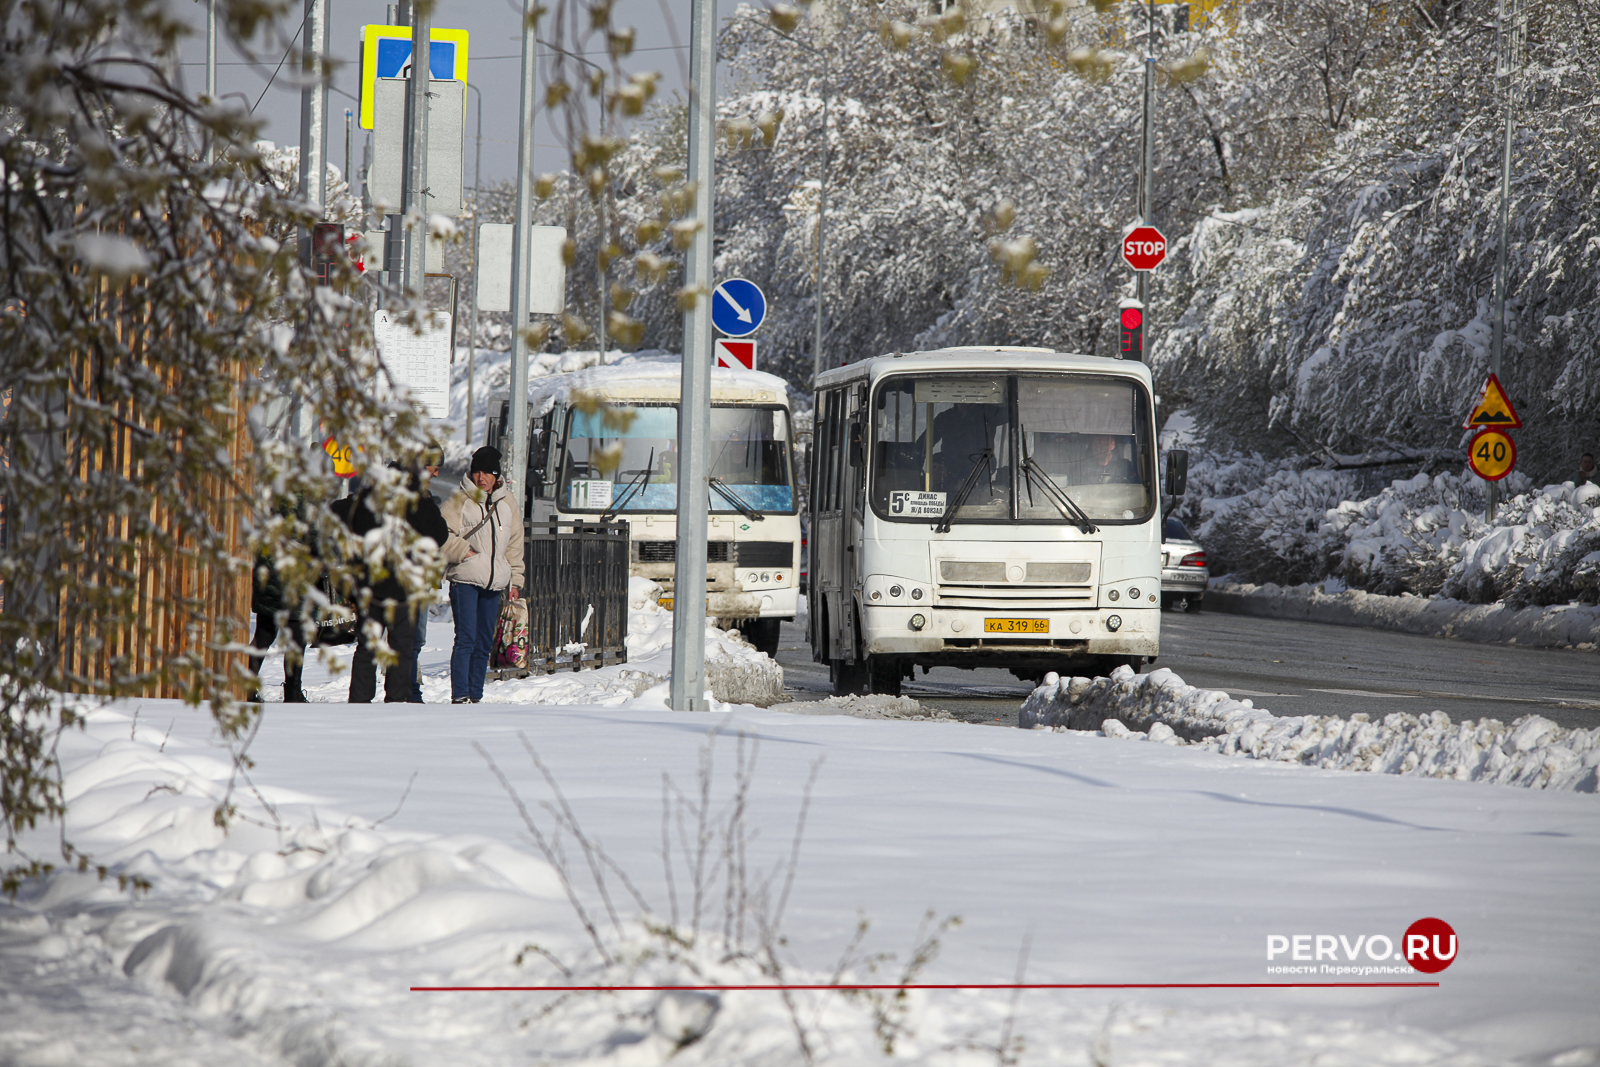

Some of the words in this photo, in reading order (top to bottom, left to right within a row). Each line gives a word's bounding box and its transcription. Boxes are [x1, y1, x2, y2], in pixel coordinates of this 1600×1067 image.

[1125, 241, 1165, 256] STOP
[1121, 331, 1143, 352] 31
[1476, 441, 1506, 462] 40
[573, 481, 588, 507] 11
[910, 506, 922, 514] Ж/Д
[923, 506, 943, 514] ВОКЗАЛ
[989, 622, 1003, 631] КА
[1007, 620, 1029, 632] 319
[1034, 620, 1045, 629] 66
